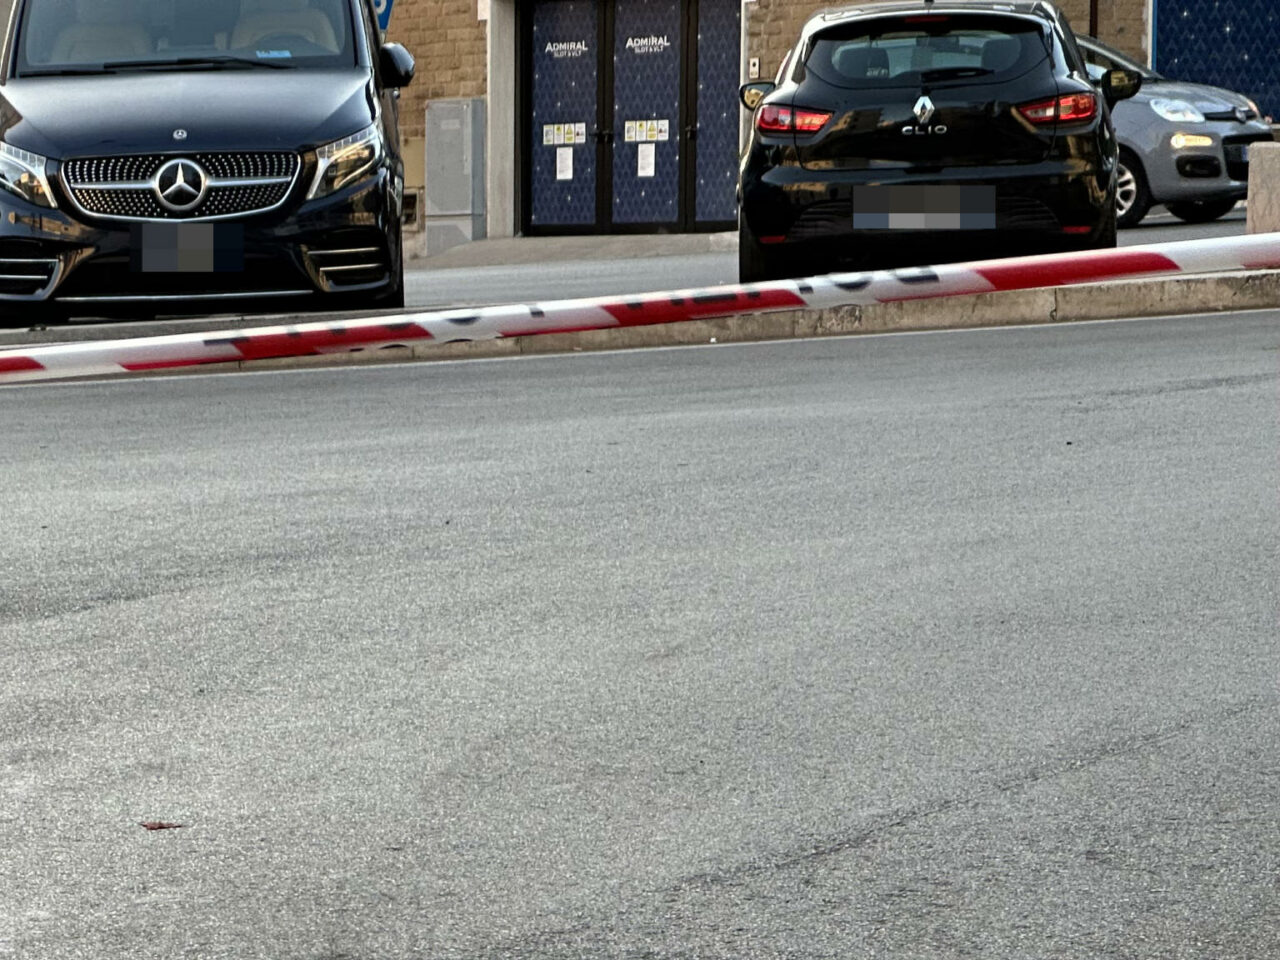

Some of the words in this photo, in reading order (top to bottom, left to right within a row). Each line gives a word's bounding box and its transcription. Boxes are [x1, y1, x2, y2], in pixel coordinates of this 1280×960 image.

[545, 40, 588, 53] ADMIRAL
[625, 35, 670, 49] ADMIRAL
[902, 125, 947, 135] CLIO
